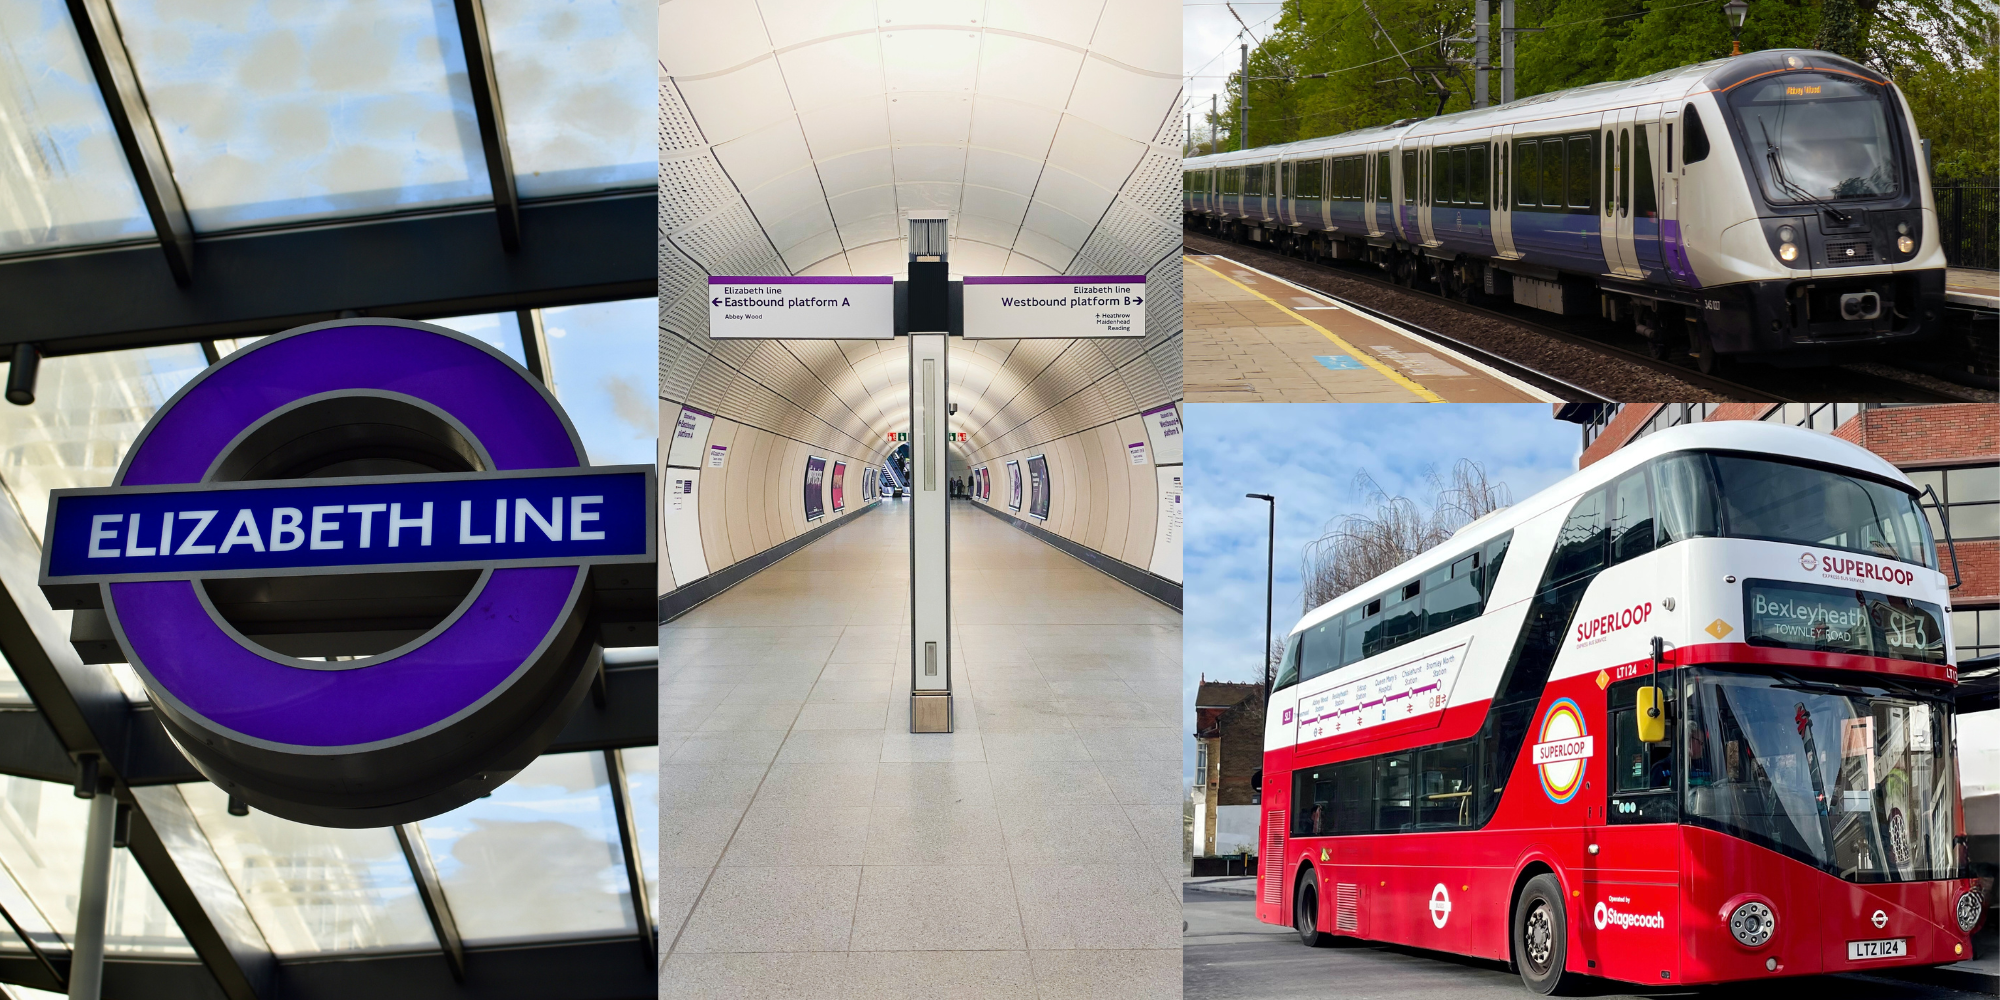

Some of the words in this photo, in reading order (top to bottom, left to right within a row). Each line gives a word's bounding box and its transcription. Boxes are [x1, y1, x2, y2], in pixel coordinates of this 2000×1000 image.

[724, 286, 764, 294] Elizabeth
[766, 286, 782, 294] line
[1074, 286, 1112, 294] Elizabeth
[1116, 286, 1131, 294] line
[724, 297, 784, 307] Eastbound
[788, 296, 838, 309] platform
[842, 298, 850, 306] A
[1002, 296, 1066, 307] Westbound
[1070, 296, 1120, 308] platform
[1124, 296, 1131, 306] B
[87, 501, 433, 558] ELIZABETH
[459, 495, 606, 544] LINE
[1822, 556, 1914, 586] SUPERLOOP
[1756, 594, 1866, 628] Bexleyheath
[1577, 602, 1652, 642] SUPERLOOP
[1774, 624, 1822, 638] TOWNLEY
[1826, 629, 1850, 642] ROAD
[1890, 612, 1926, 650] SL3
[1426, 661, 1442, 670] Bromley
[1442, 655, 1455, 665] North
[1432, 668, 1447, 678] Station
[1616, 664, 1637, 679] LT124
[1375, 678, 1386, 687] Queen
[1404, 677, 1418, 686] Station
[1540, 742, 1585, 759] SUPERLOOP
[1608, 908, 1664, 930] Stagecoach
[1857, 943, 1877, 956] LTZ
[1880, 941, 1898, 955] 1124
